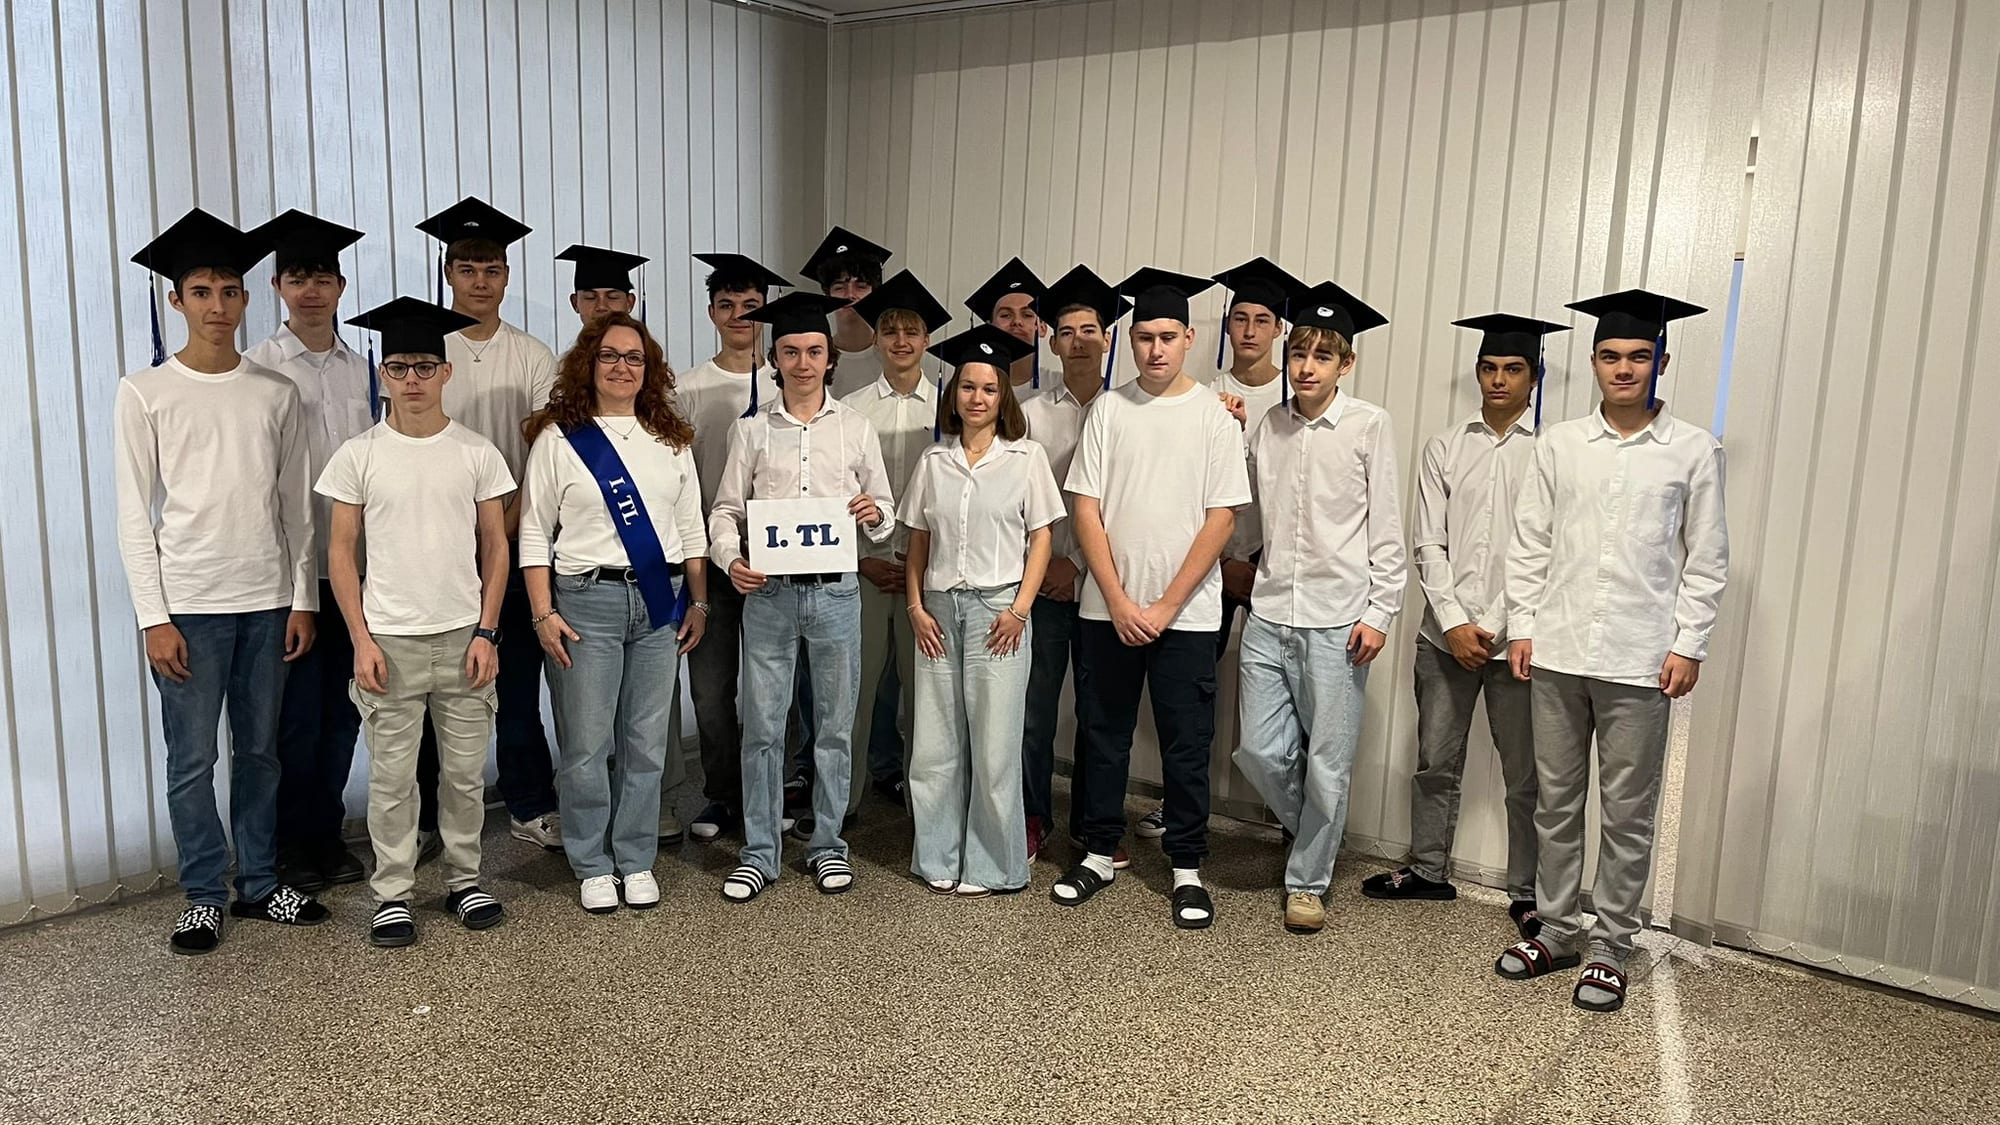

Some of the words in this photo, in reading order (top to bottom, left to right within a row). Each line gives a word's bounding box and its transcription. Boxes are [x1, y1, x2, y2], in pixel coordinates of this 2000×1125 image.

[608, 476, 625, 494] I.
[617, 495, 639, 525] TL
[765, 525, 788, 548] I.
[796, 523, 840, 546] TL
[1581, 968, 1621, 987] FILA
